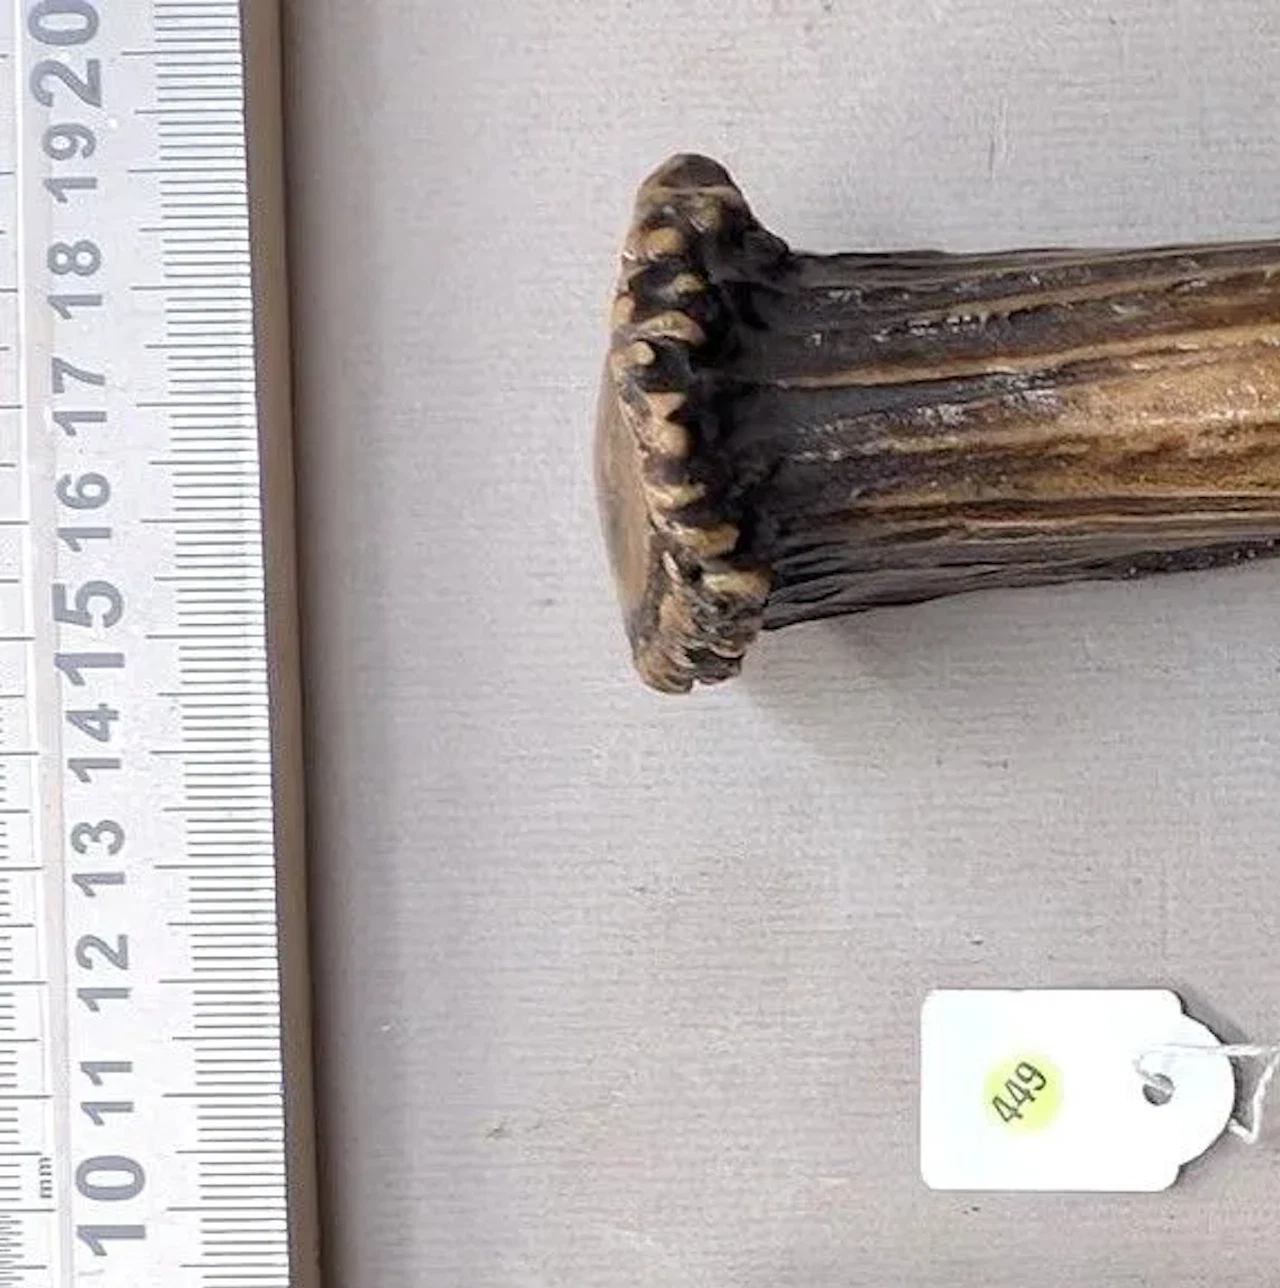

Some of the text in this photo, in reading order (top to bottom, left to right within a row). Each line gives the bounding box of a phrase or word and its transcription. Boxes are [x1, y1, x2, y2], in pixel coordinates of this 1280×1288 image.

[27, 0, 101, 107] 20
[42, 123, 98, 203] 19
[46, 239, 102, 320] 18
[51, 356, 107, 436] 17
[55, 472, 112, 552] 16
[52, 579, 125, 687] 15
[65, 702, 121, 783] 14
[70, 819, 126, 897] 13
[75, 934, 133, 1012] 12
[80, 1061, 134, 1126] 11
[992, 1062, 1047, 1123] 449
[39, 1157, 53, 1199] mm
[75, 1155, 146, 1257] 10
